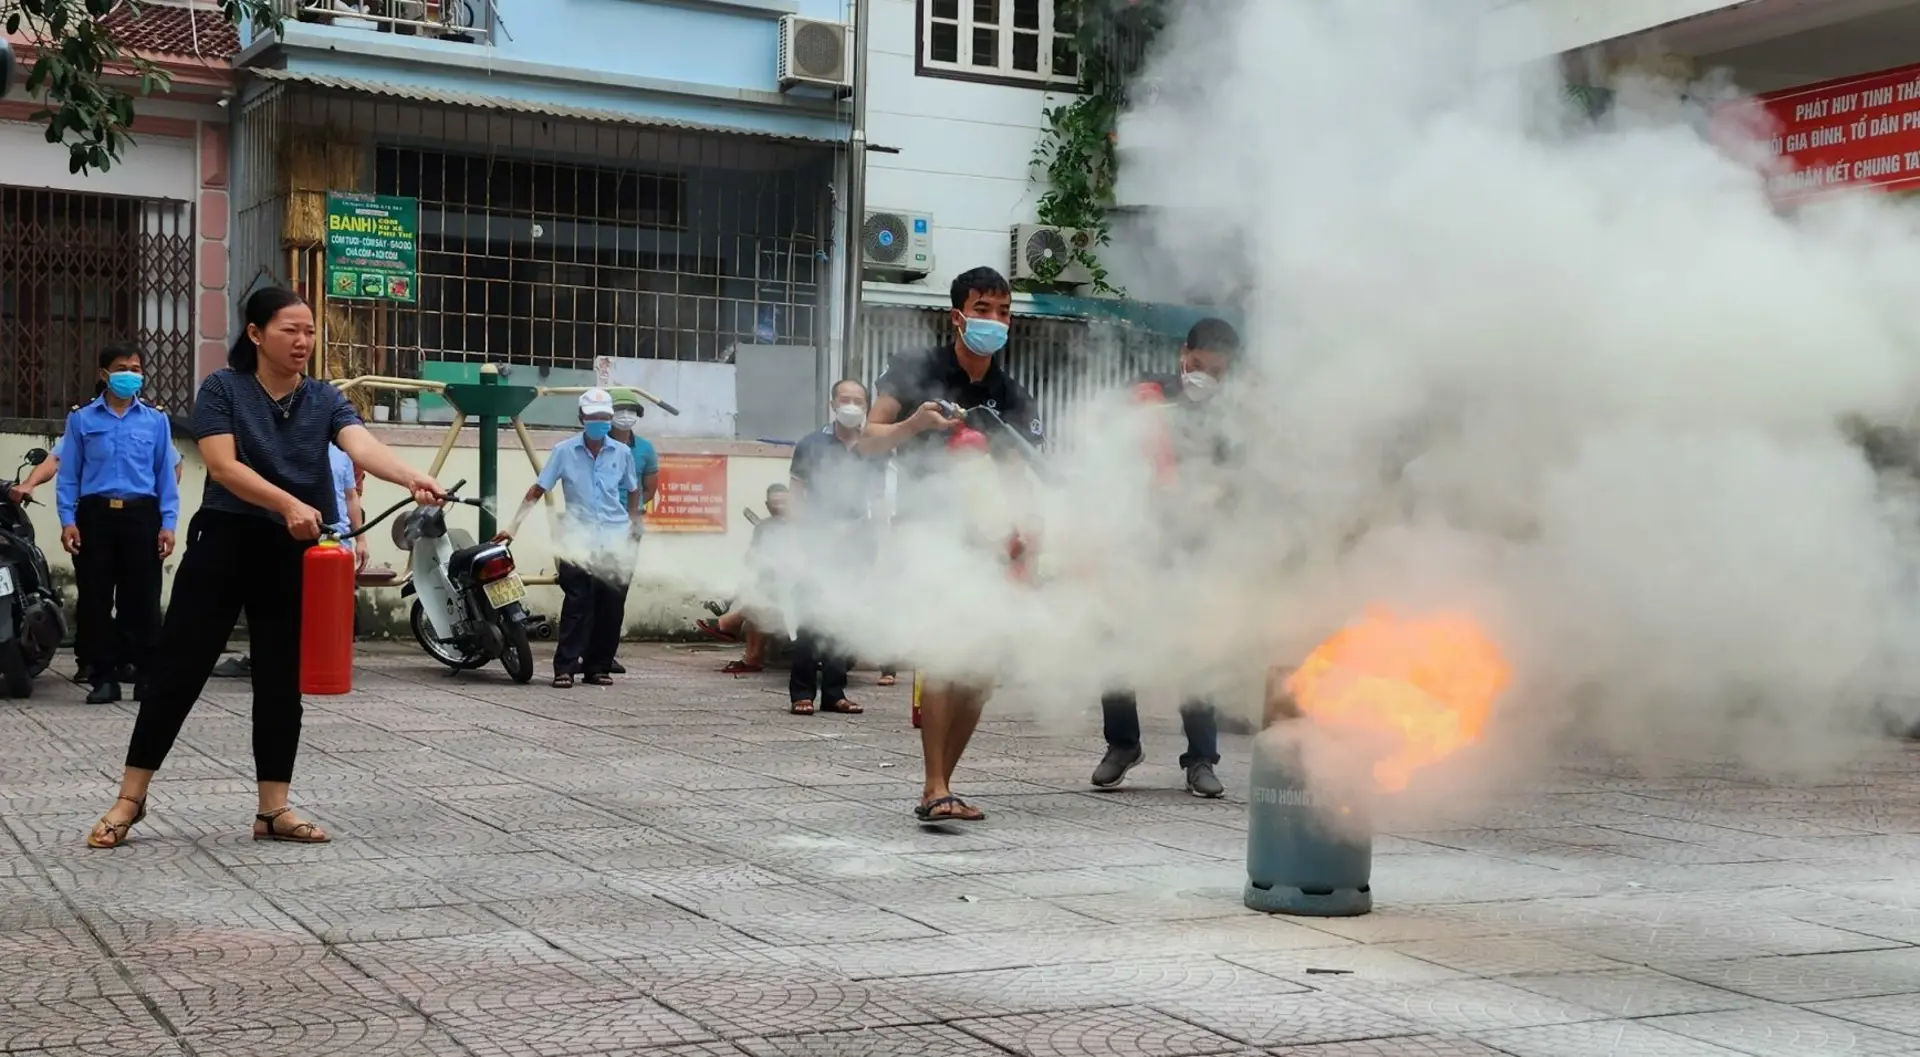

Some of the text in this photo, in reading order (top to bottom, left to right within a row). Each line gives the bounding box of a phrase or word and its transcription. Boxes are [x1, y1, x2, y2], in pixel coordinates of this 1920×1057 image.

[1795, 97, 1829, 122] PHÁT
[1832, 93, 1858, 114] HUY
[1862, 86, 1893, 108] TINH
[1787, 133, 1808, 152] GIA
[1811, 125, 1846, 149] ĐÌNH,
[1850, 113, 1868, 140] TỔ
[1870, 113, 1899, 137] DÂN
[1826, 158, 1850, 183] KẾT
[1854, 154, 1900, 179] CHUNG
